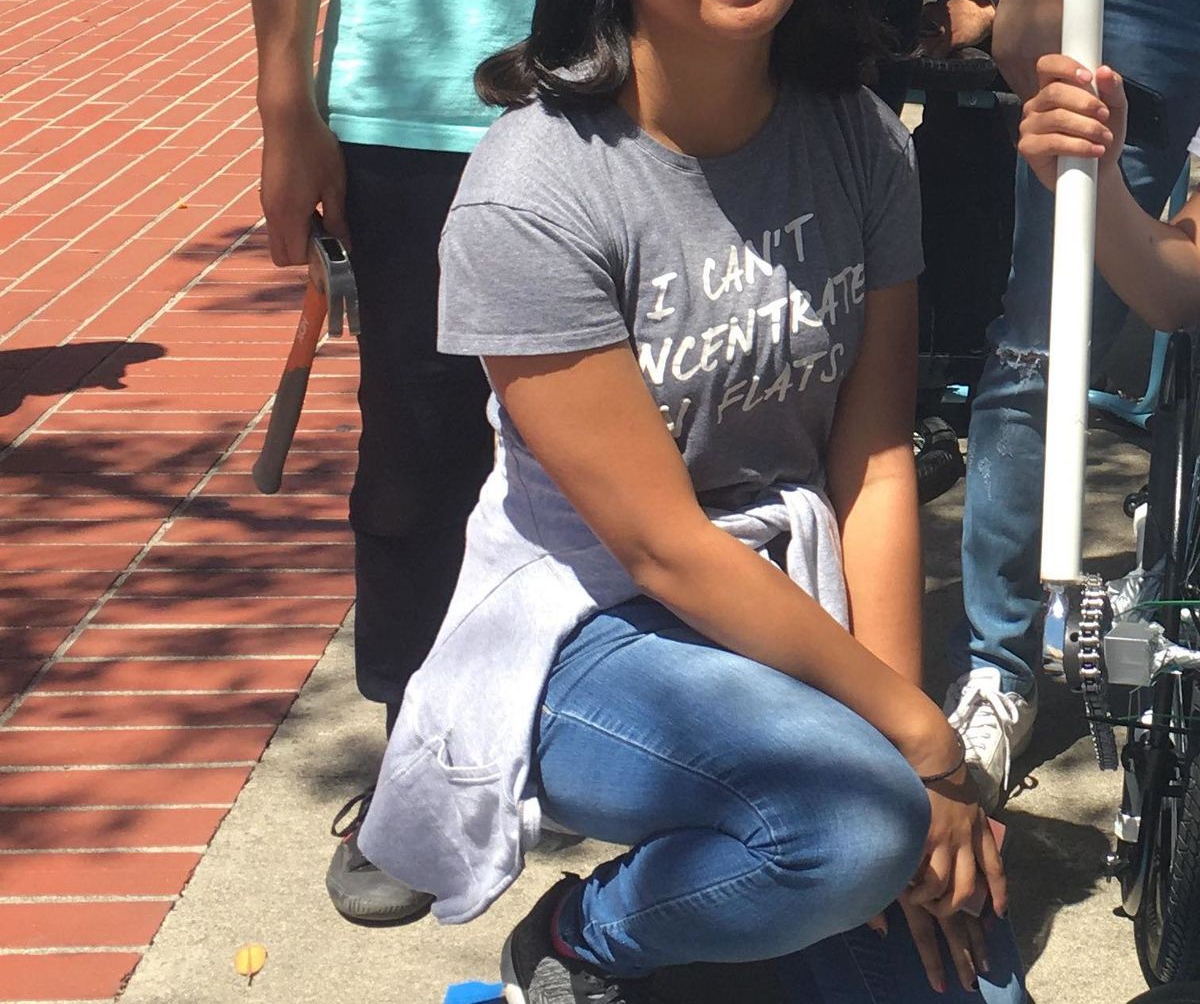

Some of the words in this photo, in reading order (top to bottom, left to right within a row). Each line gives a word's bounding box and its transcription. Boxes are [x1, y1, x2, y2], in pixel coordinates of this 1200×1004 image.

[638, 262, 865, 385] NCENTRATE
[646, 271, 678, 321] I
[702, 212, 815, 301] CAN'T
